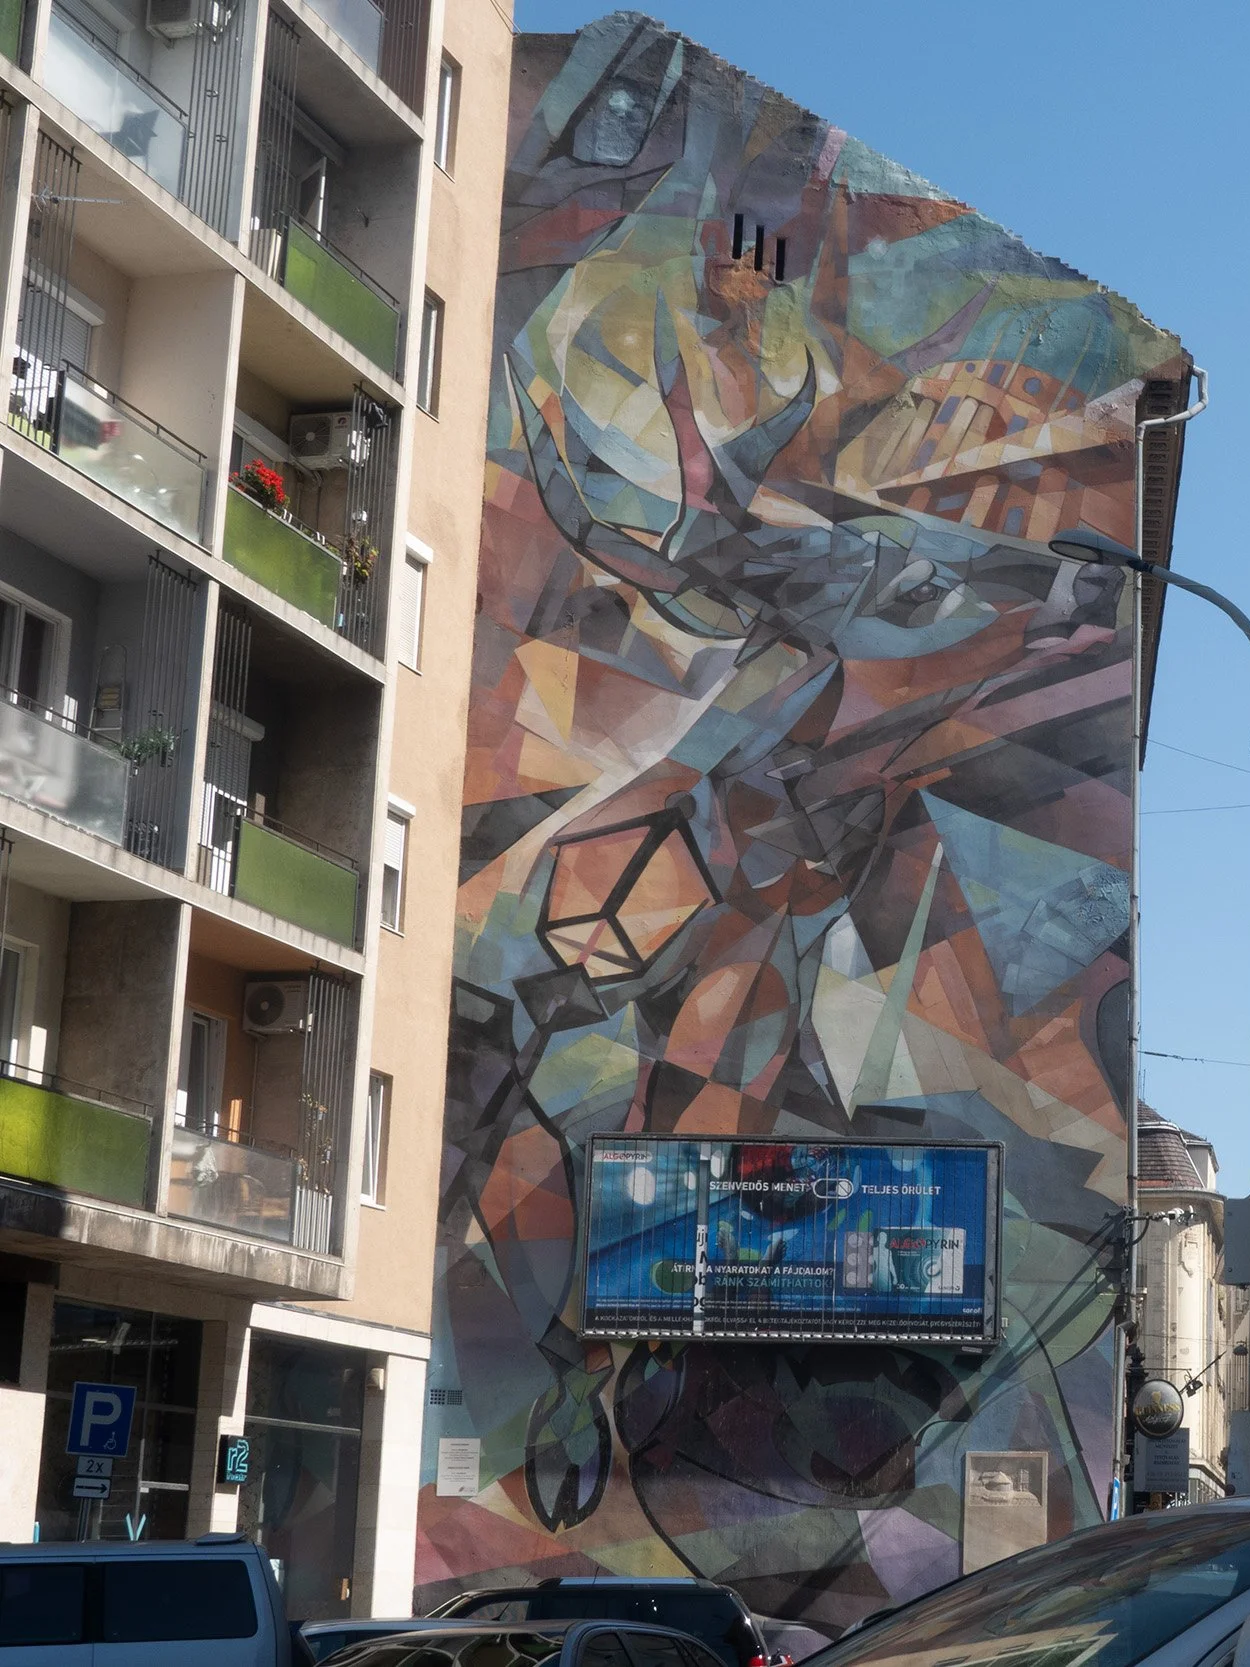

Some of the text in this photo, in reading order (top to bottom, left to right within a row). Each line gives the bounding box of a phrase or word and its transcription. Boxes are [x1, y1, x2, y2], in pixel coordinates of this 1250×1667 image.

[709, 1179, 806, 1193] SZENVEDŐS MENET
[861, 1183, 941, 1196] TELJES ŐRÜLET
[715, 1265, 773, 1275] NYARATOKAT
[773, 1266, 781, 1276] A
[782, 1264, 833, 1277] FÁJDALOM?
[80, 1390, 122, 1447] P
